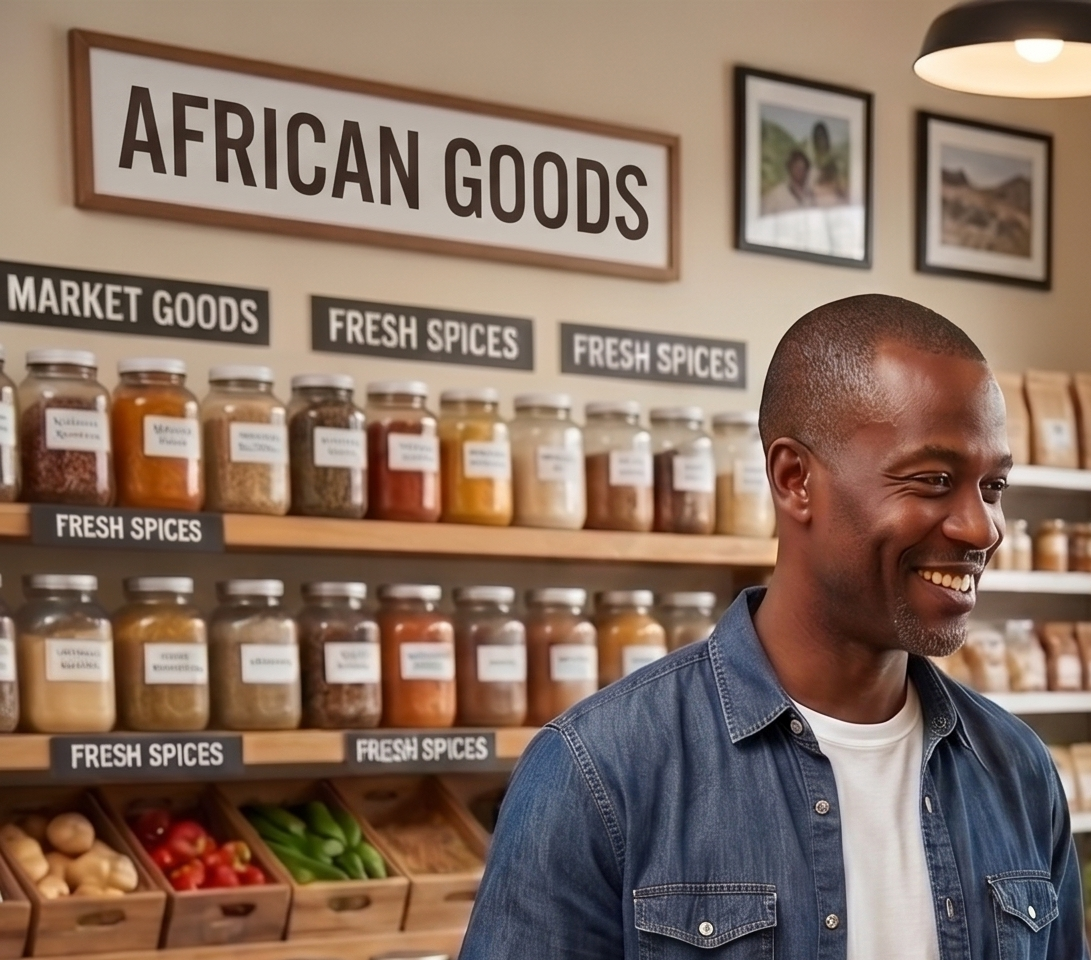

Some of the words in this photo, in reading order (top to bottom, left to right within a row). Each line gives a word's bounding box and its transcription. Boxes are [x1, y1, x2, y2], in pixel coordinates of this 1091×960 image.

[118, 85, 421, 211] AFRICAN
[444, 137, 650, 242] GOODS
[6, 273, 143, 324] MARKET
[152, 289, 260, 335] GOODS
[329, 307, 418, 350] FRESH
[426, 317, 520, 361] SPICES
[573, 333, 651, 373] FRESH
[656, 338, 740, 381] SPICES
[56, 513, 125, 540] FRESH
[130, 516, 203, 543] SPICES
[70, 744, 142, 769] FRESH
[149, 741, 224, 767] SPICES
[356, 736, 419, 763] FRESH
[421, 736, 489, 761] SPICES
